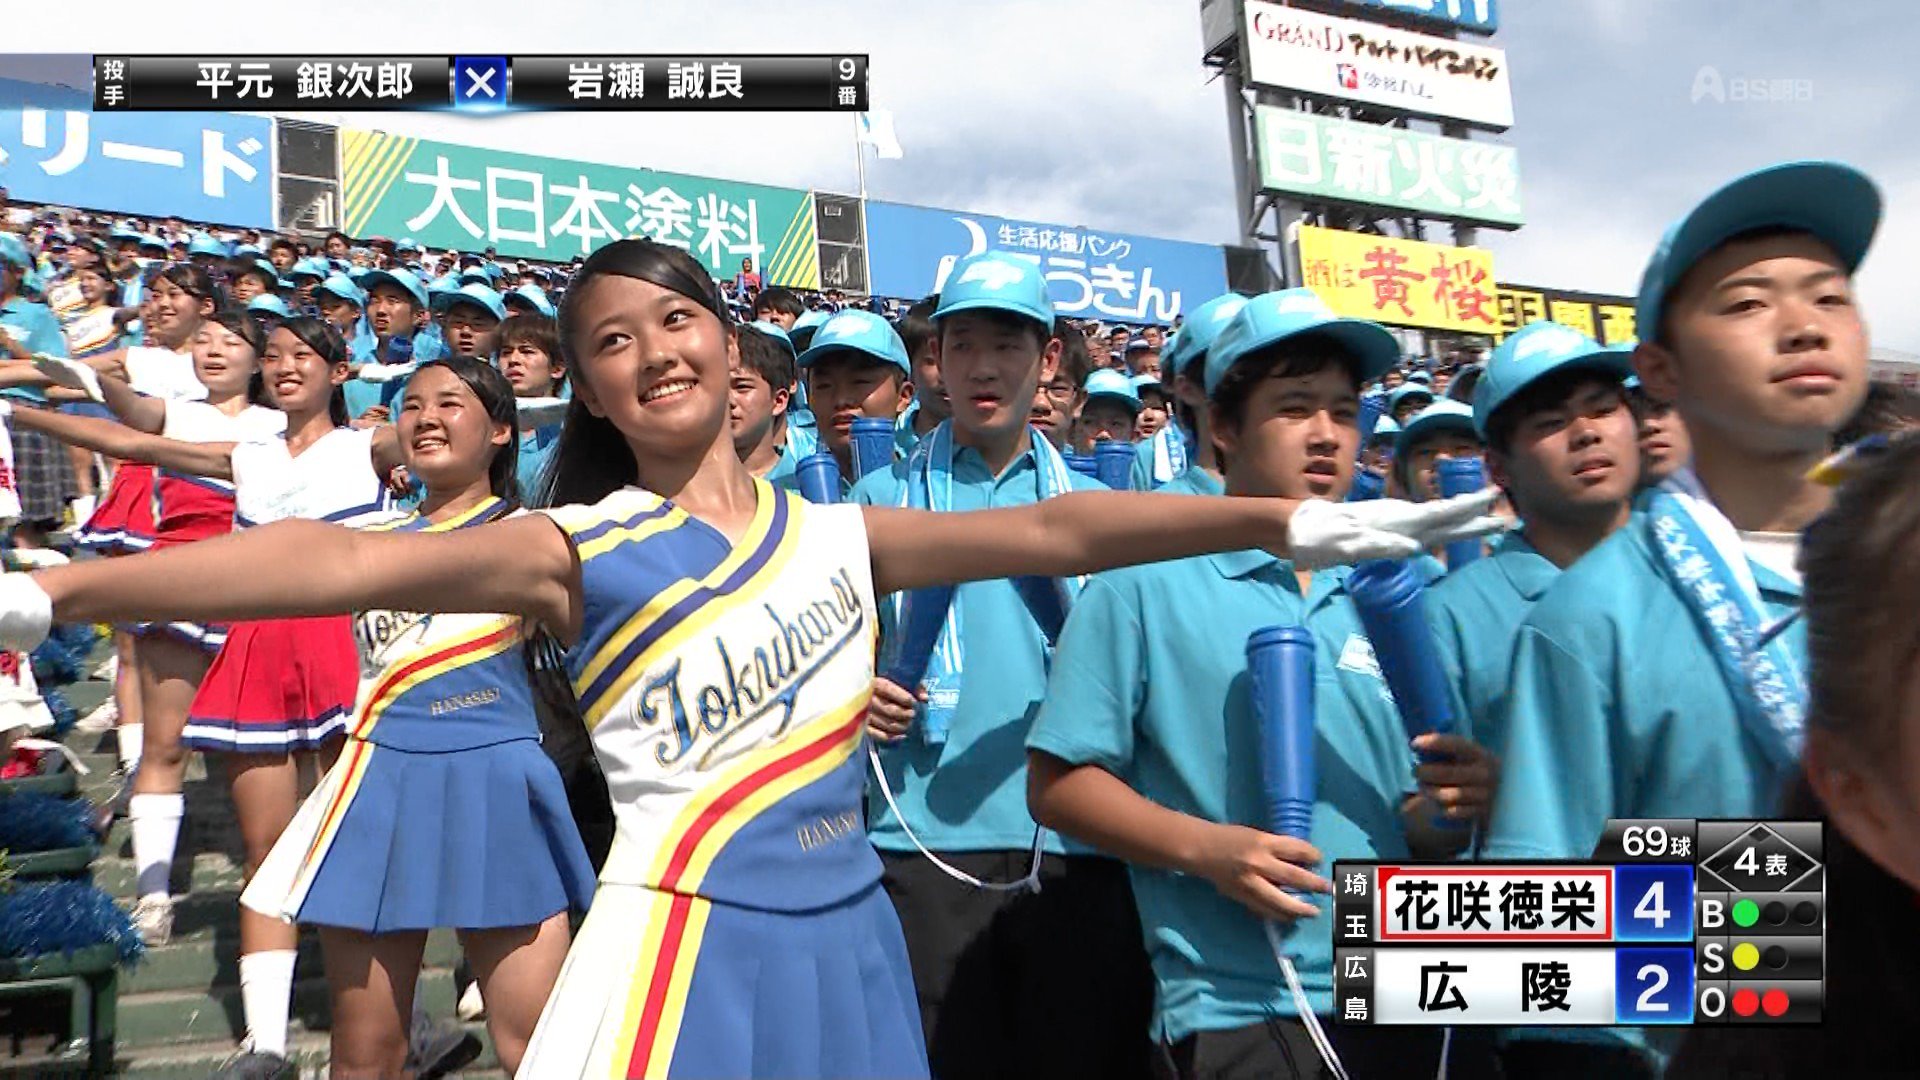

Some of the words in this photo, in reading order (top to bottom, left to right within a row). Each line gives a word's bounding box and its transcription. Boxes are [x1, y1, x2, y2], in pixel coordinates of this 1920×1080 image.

[0, 109, 264, 199] リード
[1264, 114, 1522, 215] 日新火災
[404, 155, 766, 270] 大日本塗料
[998, 223, 1133, 261] 生活応援バンク
[1004, 251, 1182, 322] うきん
[1305, 259, 1354, 288] 酒は
[1358, 245, 1496, 326] 黄桜
[637, 566, 863, 767] Tokuharu
